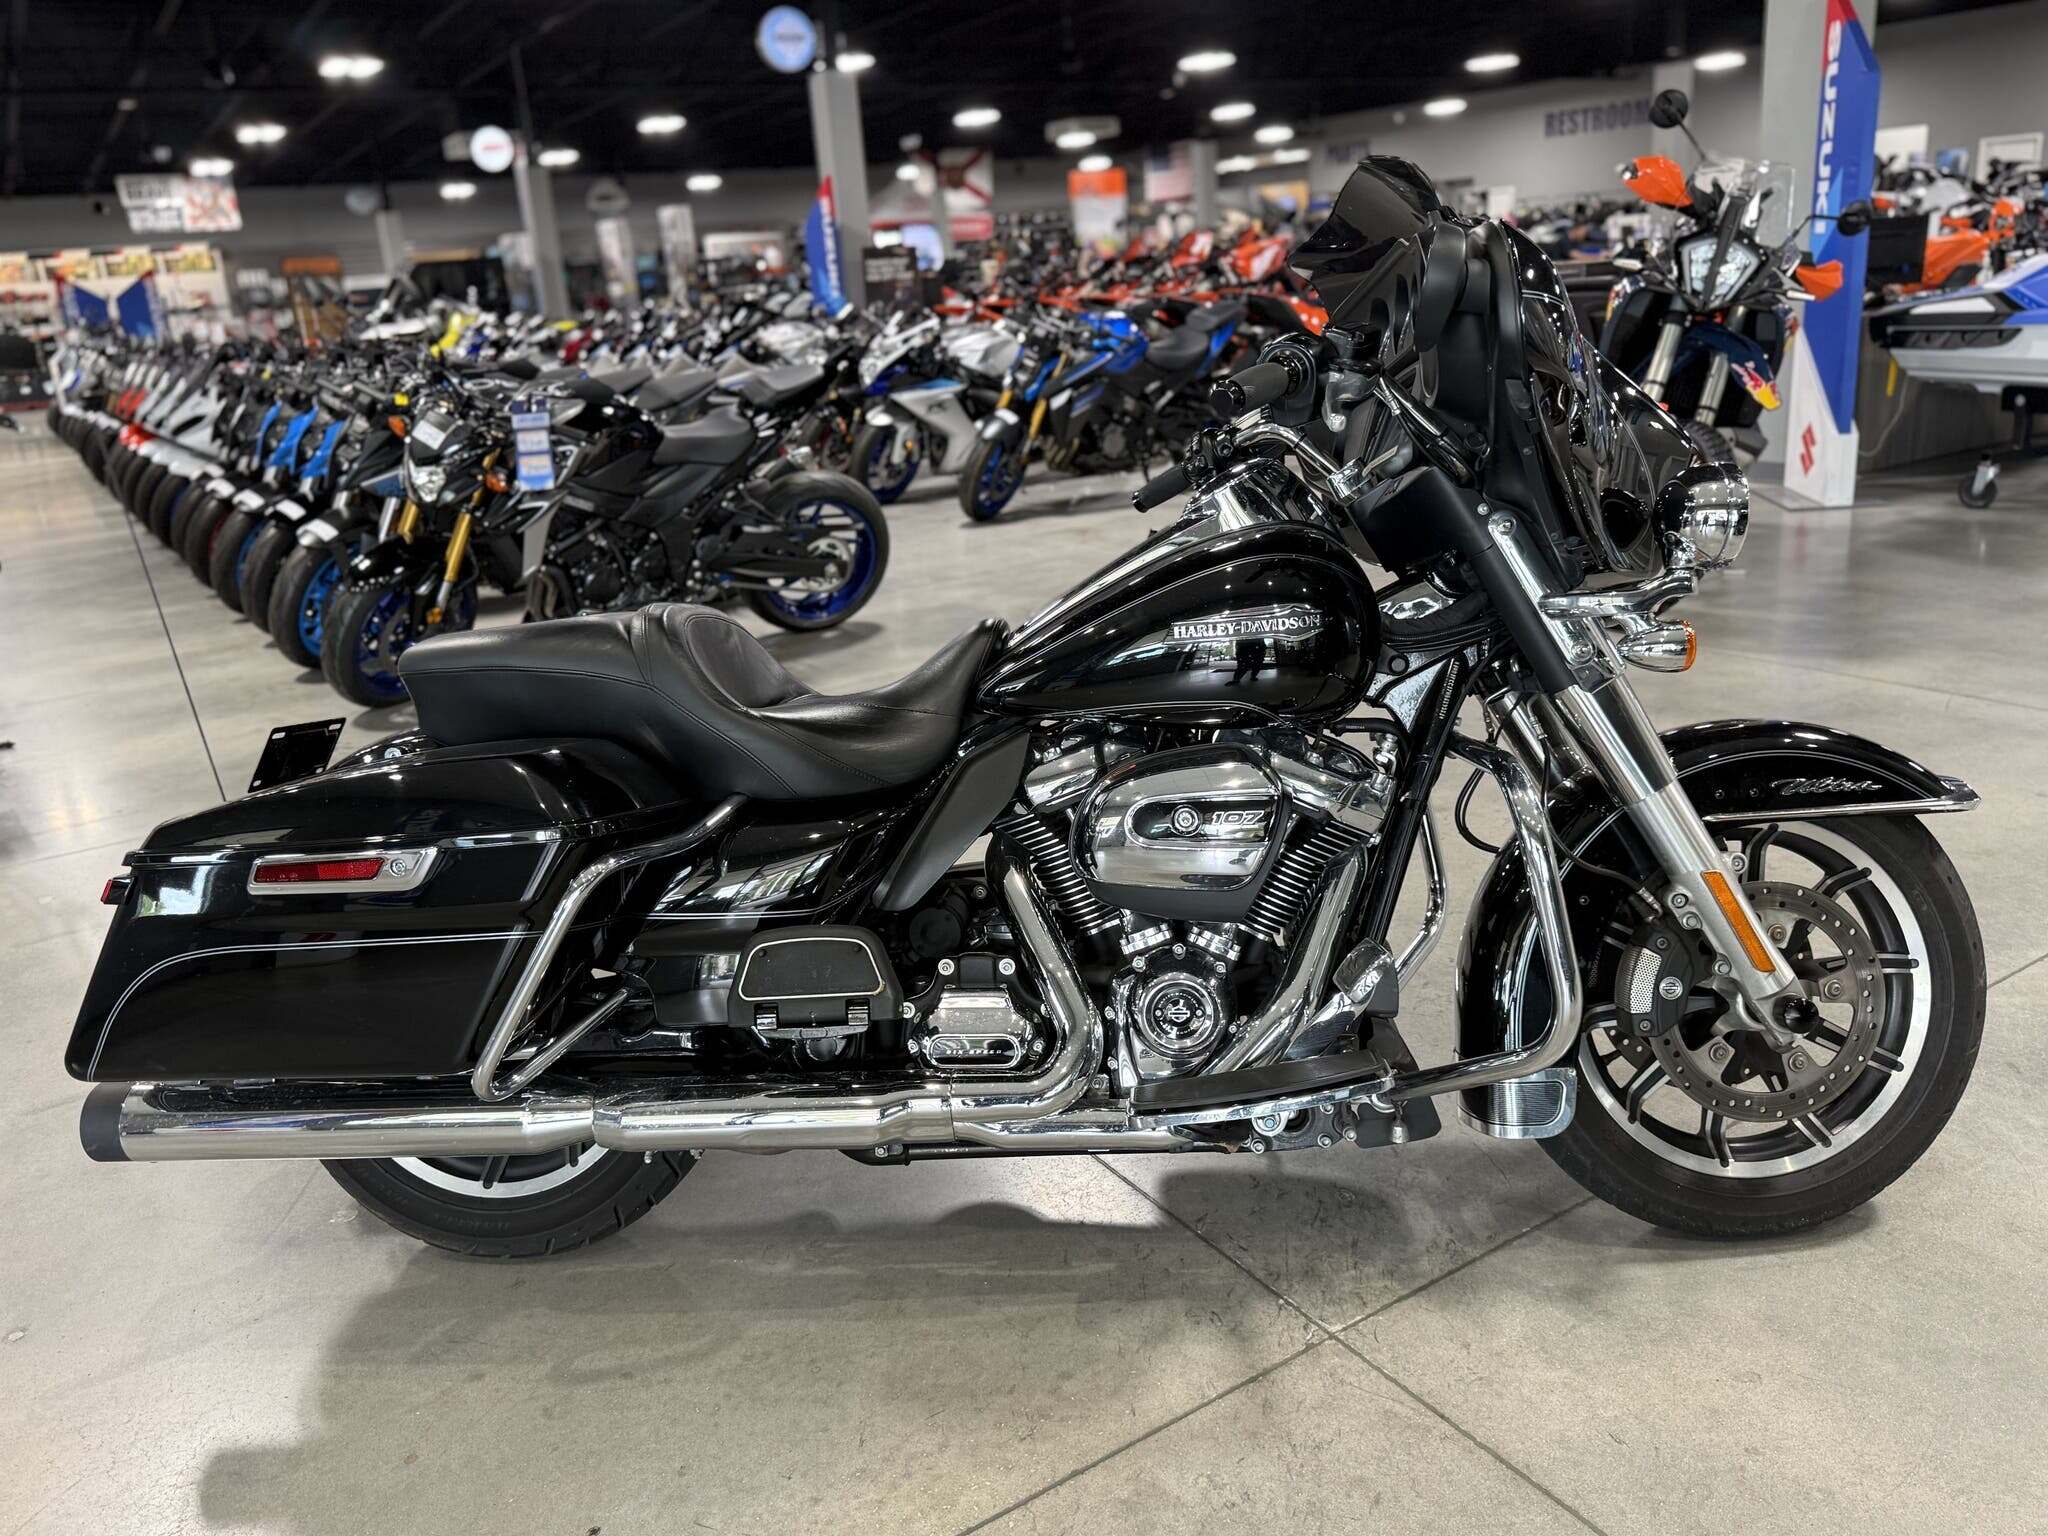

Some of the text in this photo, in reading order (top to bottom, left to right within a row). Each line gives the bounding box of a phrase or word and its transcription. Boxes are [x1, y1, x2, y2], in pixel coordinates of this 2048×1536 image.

[1813, 19, 1842, 235] SUZUKI
[1173, 614, 1320, 639] HARLEY-DAVIDSON
[1211, 810, 1265, 825] 107
